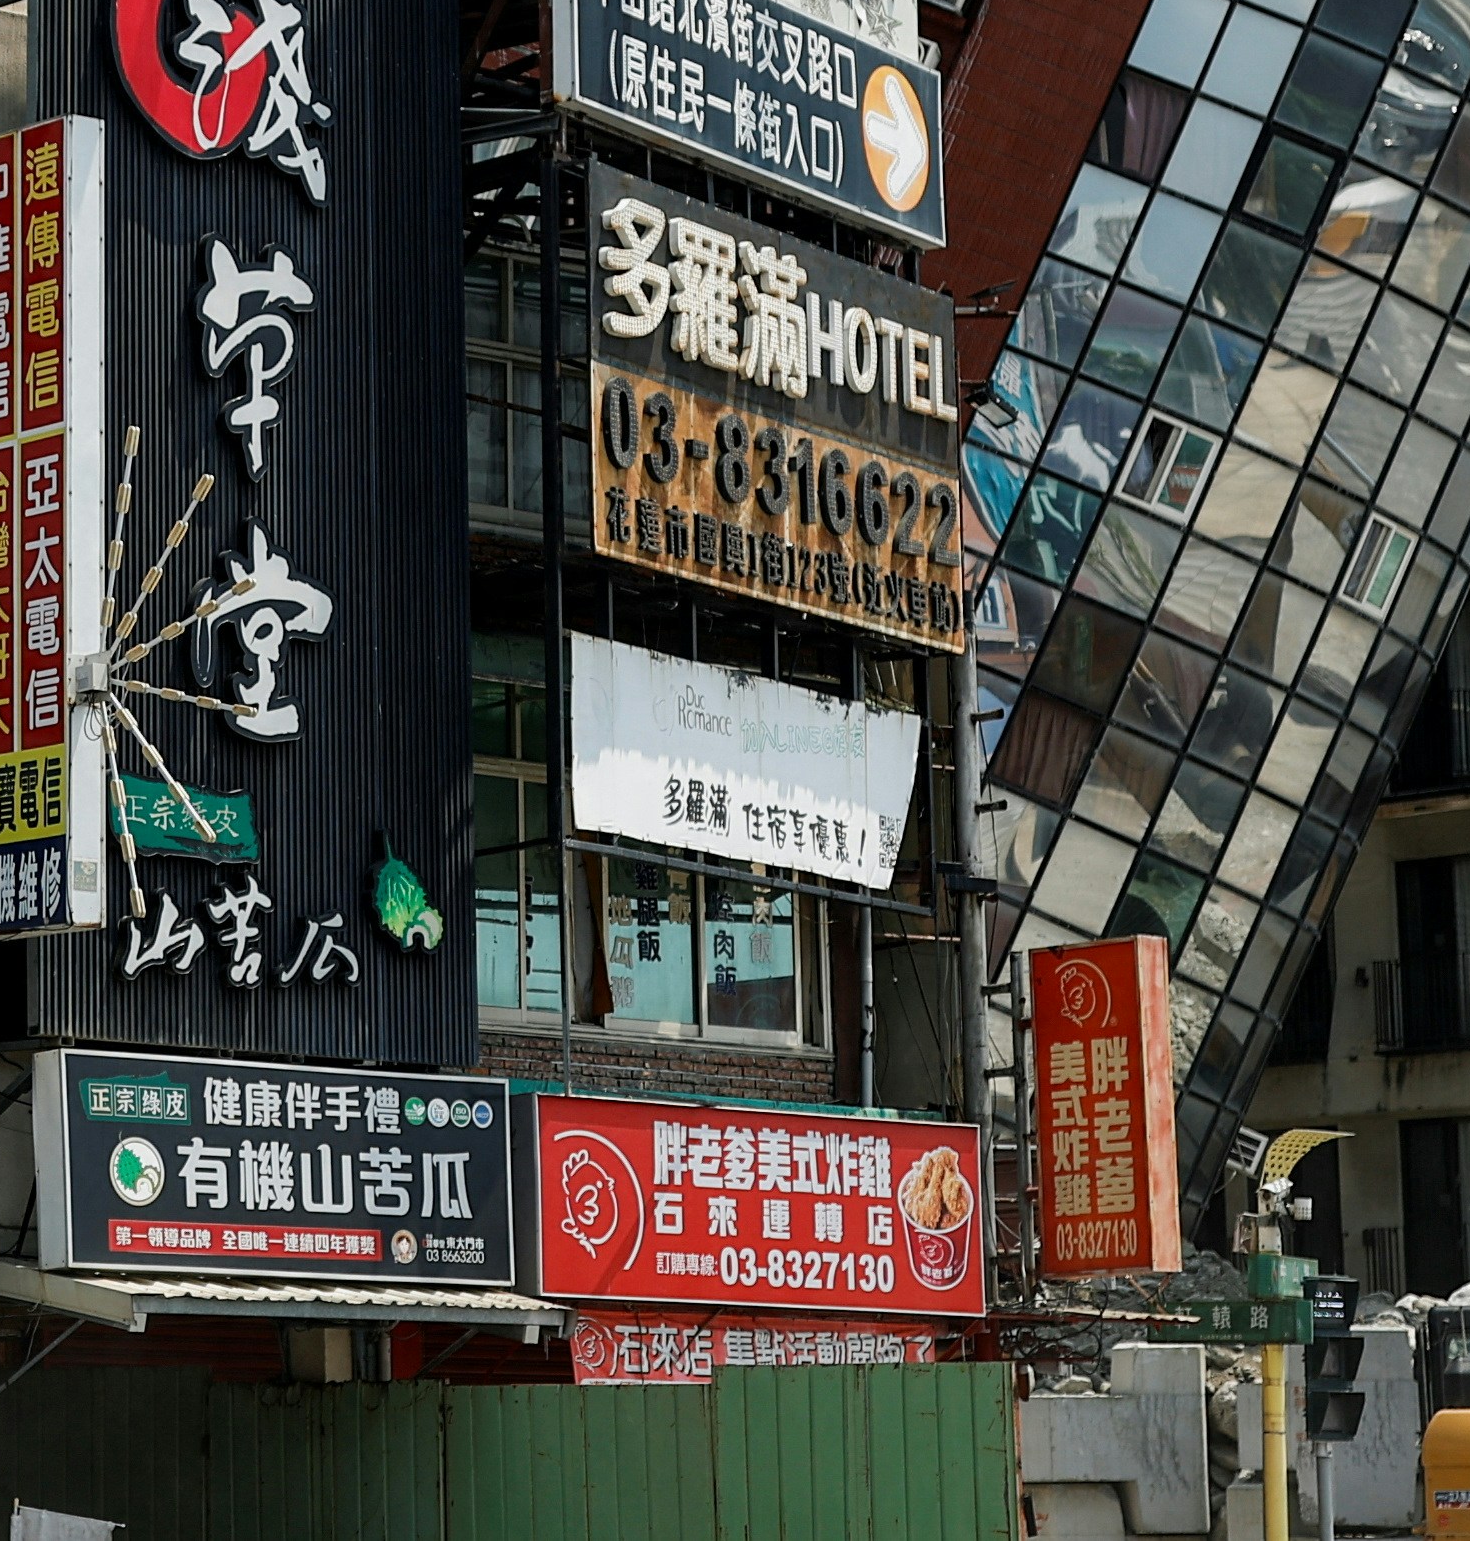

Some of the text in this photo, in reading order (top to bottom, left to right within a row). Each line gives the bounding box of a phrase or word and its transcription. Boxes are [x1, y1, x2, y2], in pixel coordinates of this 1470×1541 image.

[609, 28, 845, 189] (原住民一條街入口)
[24, 140, 61, 412] 遠傳電信
[600, 375, 960, 567] 03-8316622
[24, 453, 61, 731] 亞太電信
[664, 774, 730, 827] 多羅滿
[124, 874, 360, 984] 山苦瓜
[89, 1083, 188, 1118] 正宗綠皮
[203, 1076, 402, 1135] 健康伴手禮
[1049, 1041, 1093, 1217] 美式炸雞
[1091, 1035, 1135, 1214] 胖老爹
[177, 1136, 473, 1220] 有機山苦瓜
[654, 1120, 893, 1199] 胖老爹美式炸雞
[115, 1226, 212, 1249] 第一領導品牌
[654, 1191, 894, 1246] 石來運轉店
[1056, 1217, 1138, 1261] 03-8327130
[426, 1249, 485, 1264] 03 8663200
[719, 1247, 895, 1293] 03-8327130
[614, 1324, 713, 1376] 石來店
